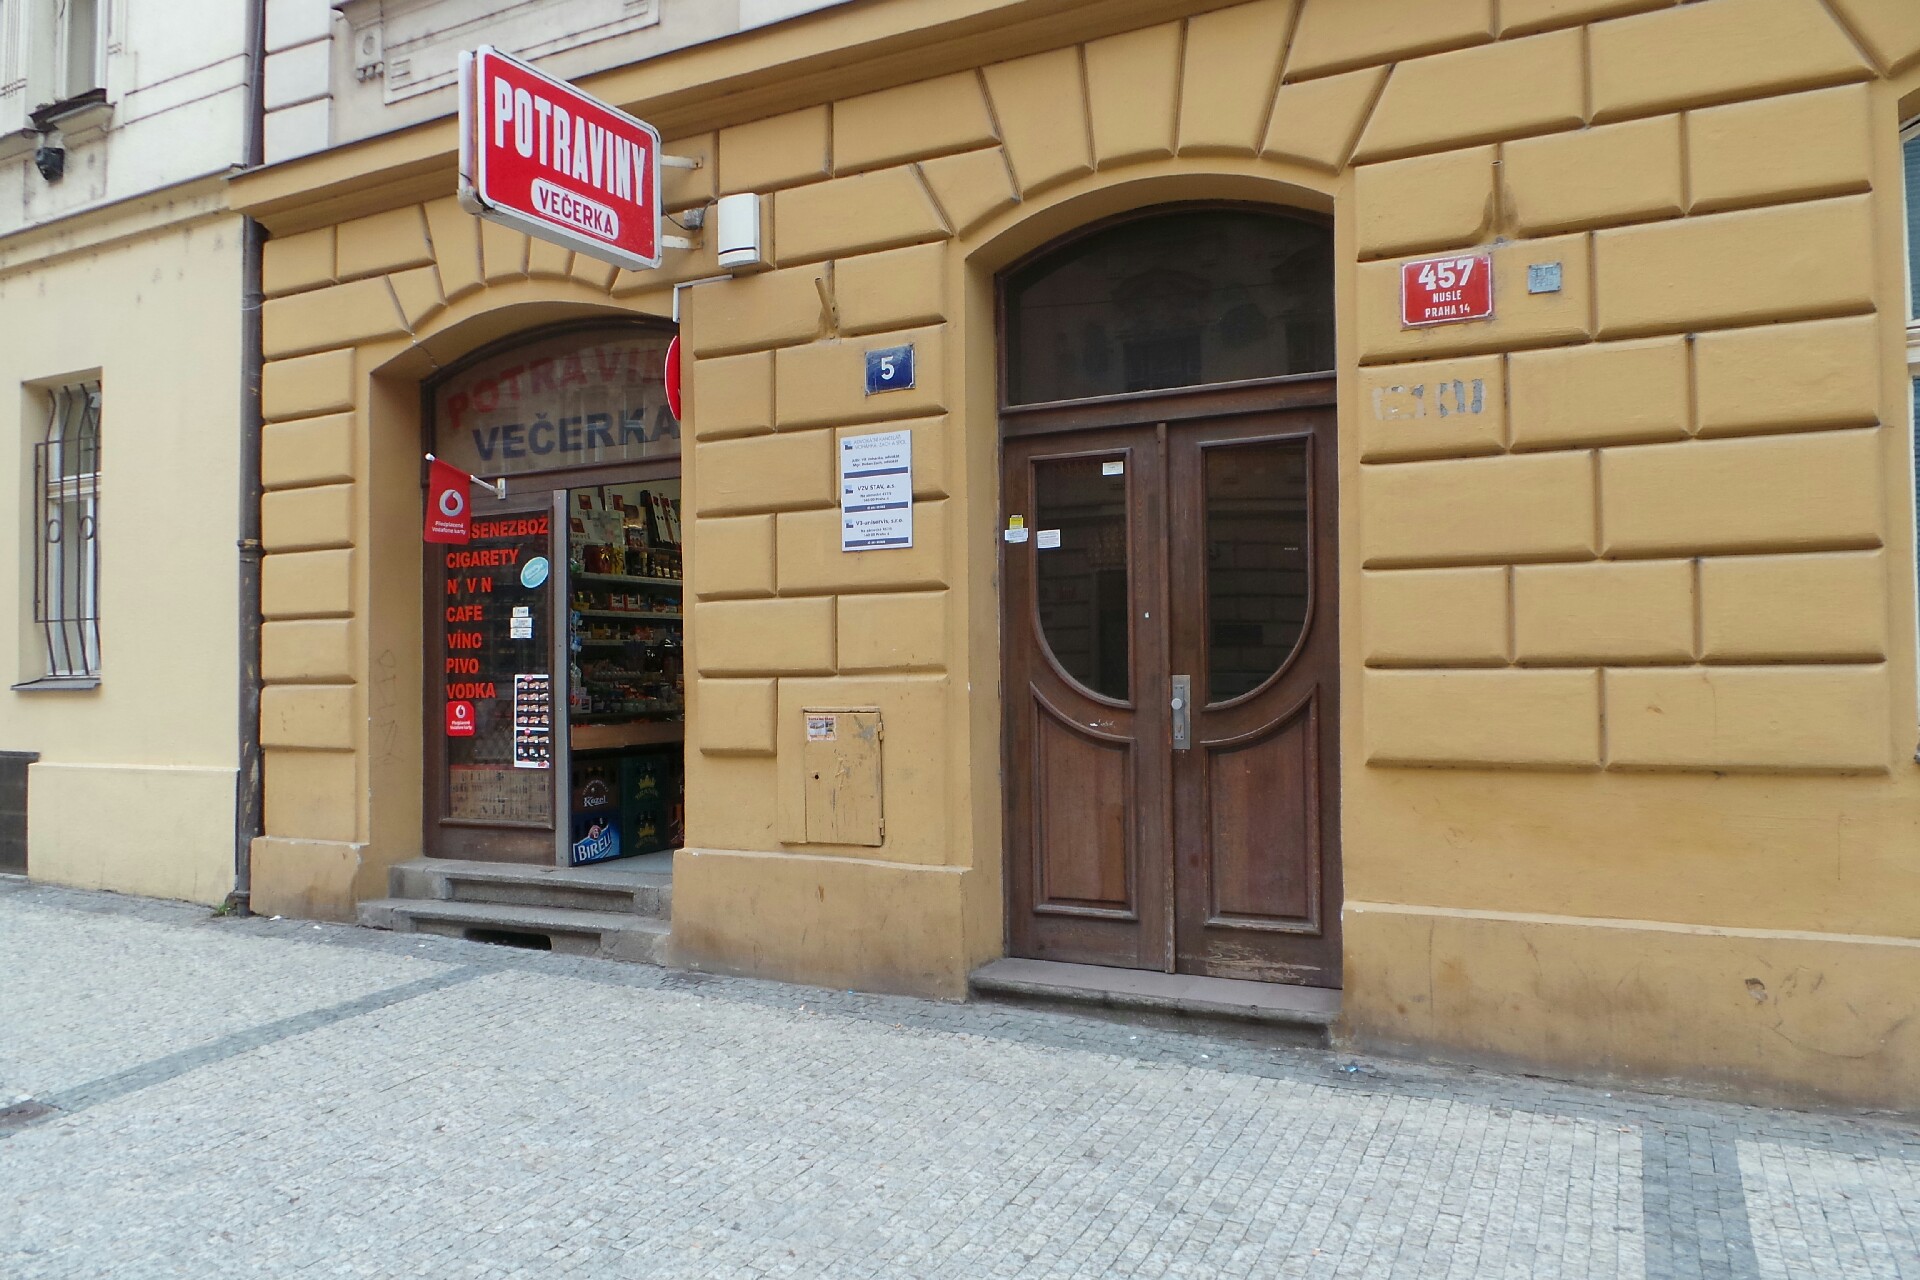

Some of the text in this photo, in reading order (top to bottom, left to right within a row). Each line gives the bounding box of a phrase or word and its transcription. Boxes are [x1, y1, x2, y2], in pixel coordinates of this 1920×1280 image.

[494, 76, 646, 206] POTRAVINY
[538, 184, 614, 236] VEČERKA
[1418, 258, 1475, 291] 457
[1432, 289, 1462, 303] NUSLE
[1425, 303, 1470, 318] PRAHA 14
[881, 355, 895, 380] 5
[447, 347, 666, 428] POTRAVIN
[472, 404, 681, 462] VEČERKA
[447, 548, 519, 569] CIGARETY
[446, 604, 483, 622] CAFE
[447, 629, 482, 649] VÍNO
[446, 657, 480, 674] PIVO
[446, 682, 496, 699] VODKA
